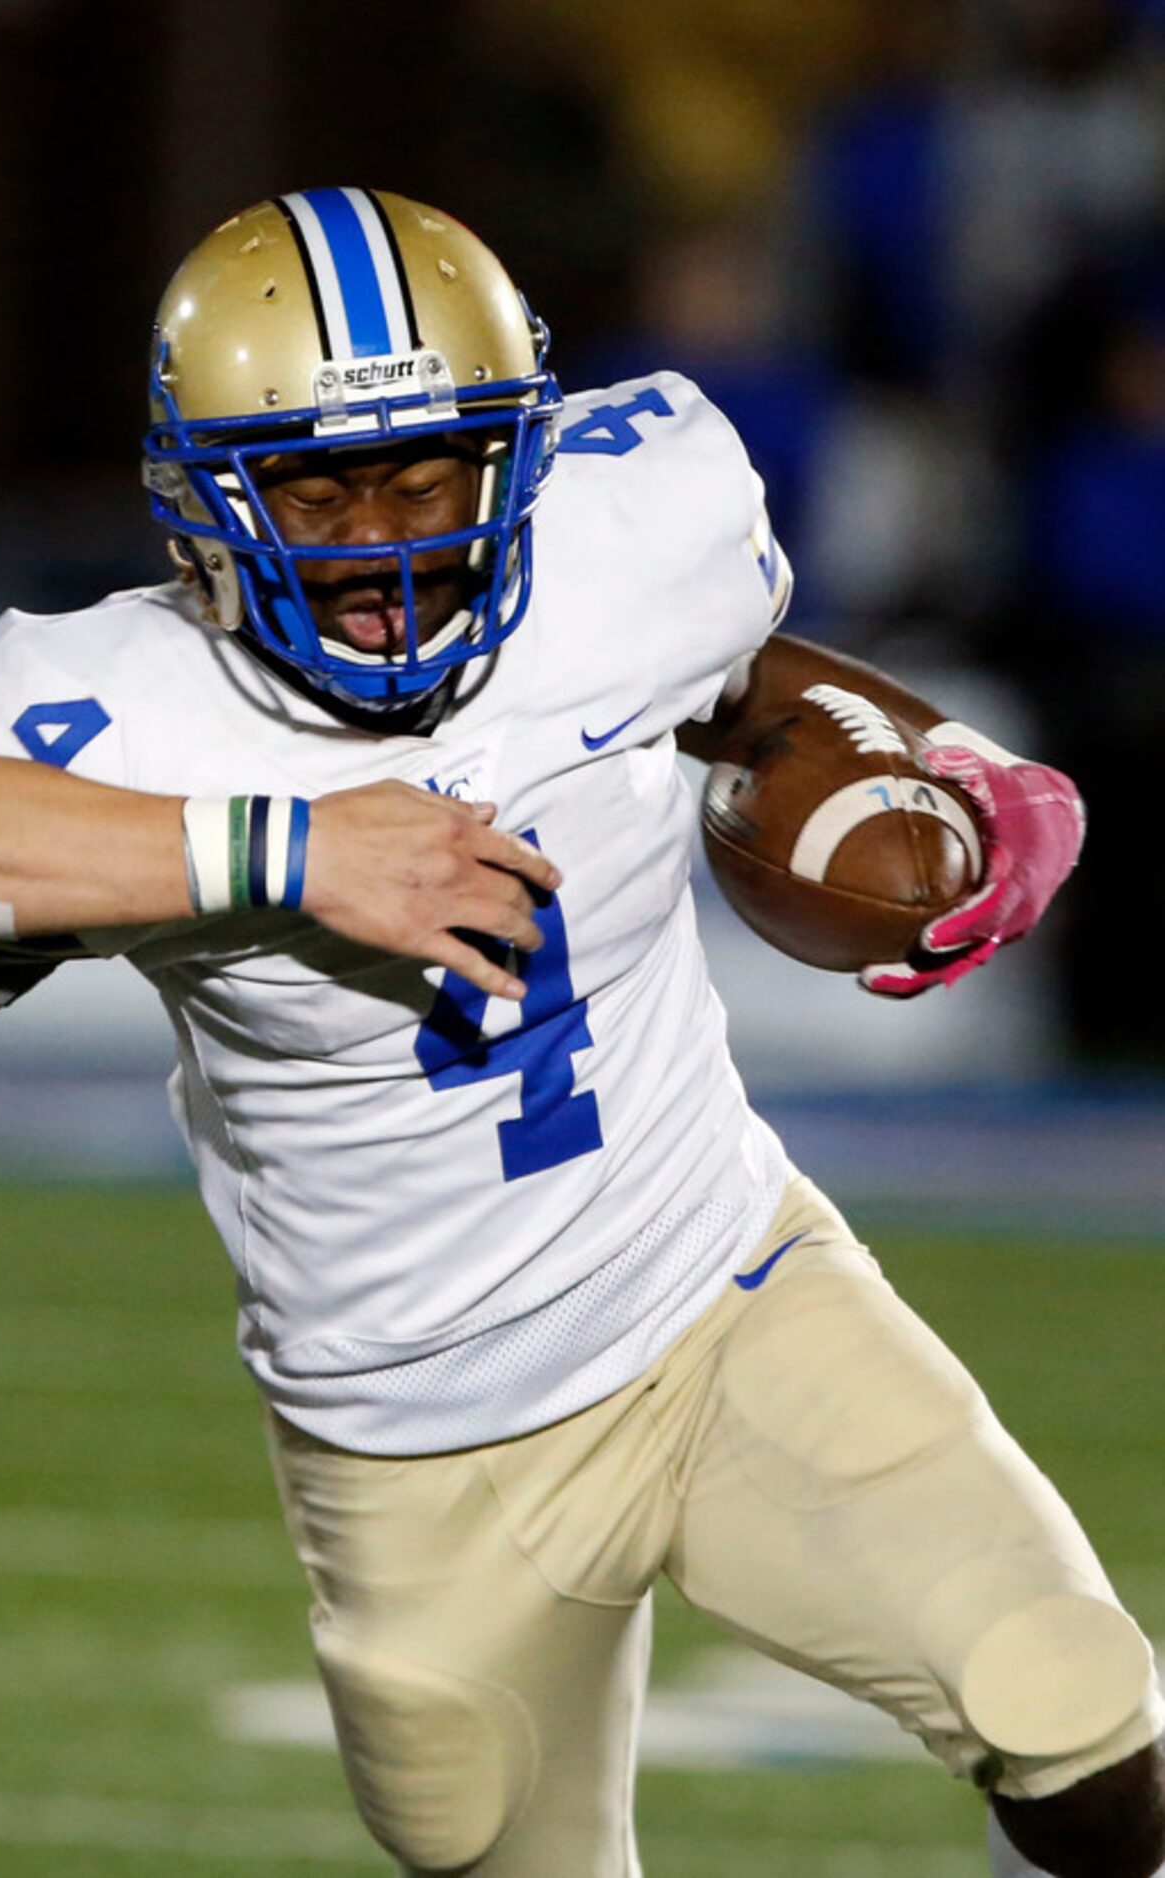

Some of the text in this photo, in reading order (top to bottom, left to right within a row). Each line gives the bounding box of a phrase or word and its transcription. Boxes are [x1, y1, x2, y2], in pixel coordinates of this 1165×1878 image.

[344, 360, 415, 384] schutt
[555, 387, 676, 456] 4
[413, 828, 604, 1182] 4
